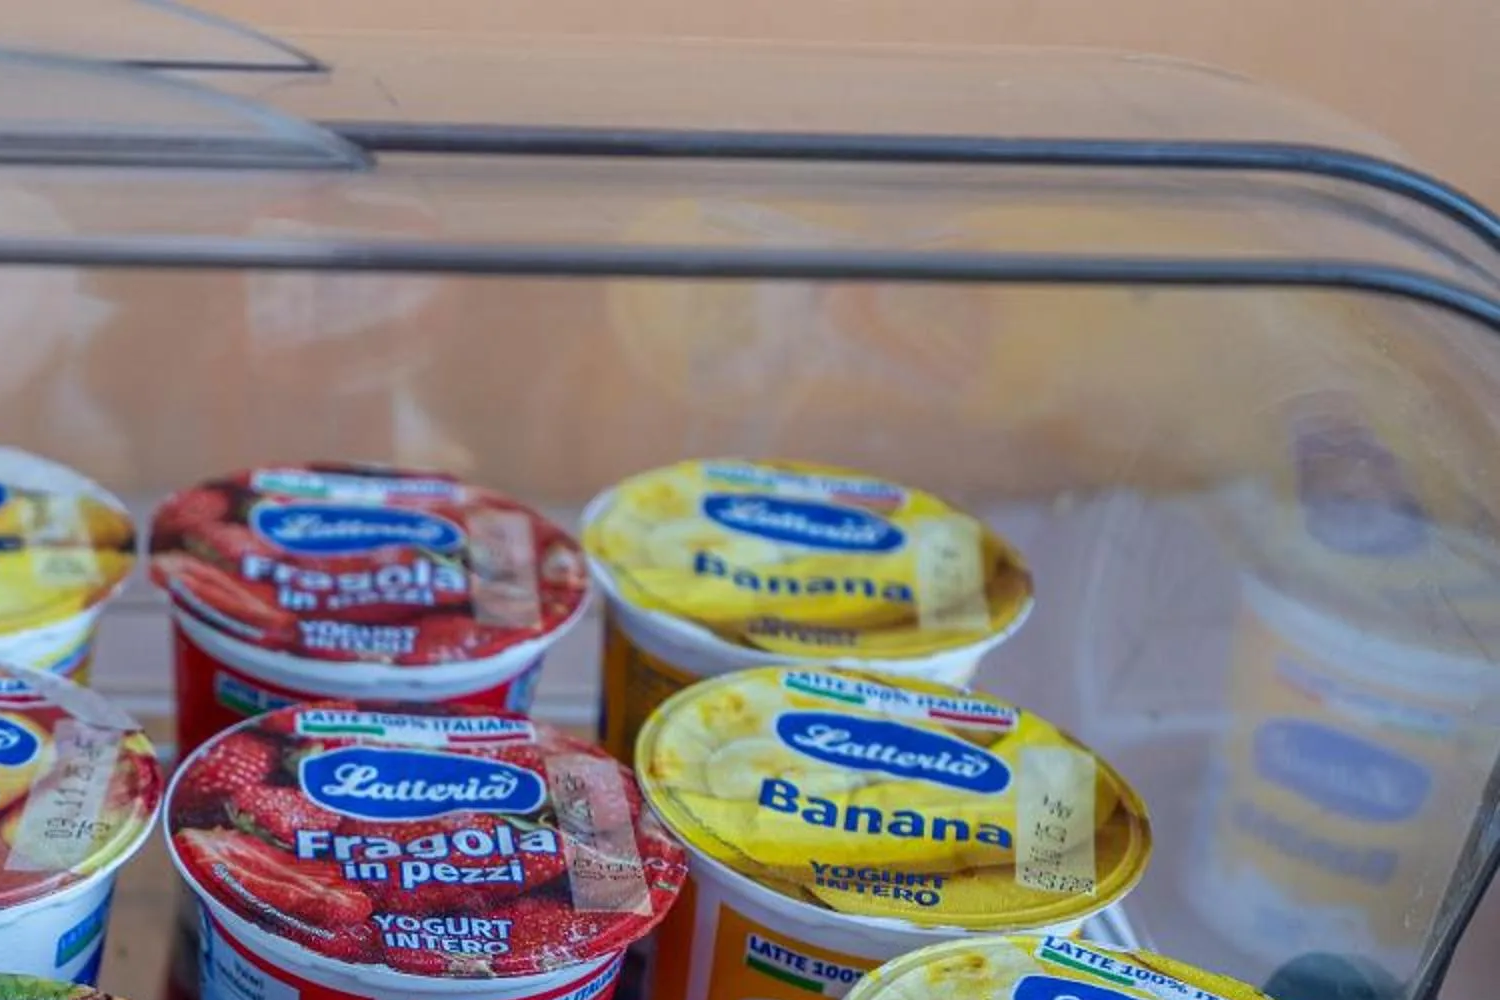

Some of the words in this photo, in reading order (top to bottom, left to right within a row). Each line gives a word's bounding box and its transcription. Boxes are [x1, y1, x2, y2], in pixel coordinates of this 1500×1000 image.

[239, 555, 468, 593] Fragola
[693, 550, 914, 603] Banana
[793, 724, 990, 780] Latteria
[320, 763, 519, 801] Latteria
[757, 778, 1015, 851] Banana
[294, 828, 559, 862] Fragola
[343, 857, 389, 882] in
[401, 858, 525, 890] pezzi
[810, 859, 948, 892] YOGURT
[814, 876, 943, 908] INTERO
[372, 913, 514, 941] YOGURT
[383, 931, 510, 955] INTERO
[749, 935, 811, 972] LATTE
[1043, 935, 1115, 974] LATTE
[1122, 962, 1190, 997] 100%
